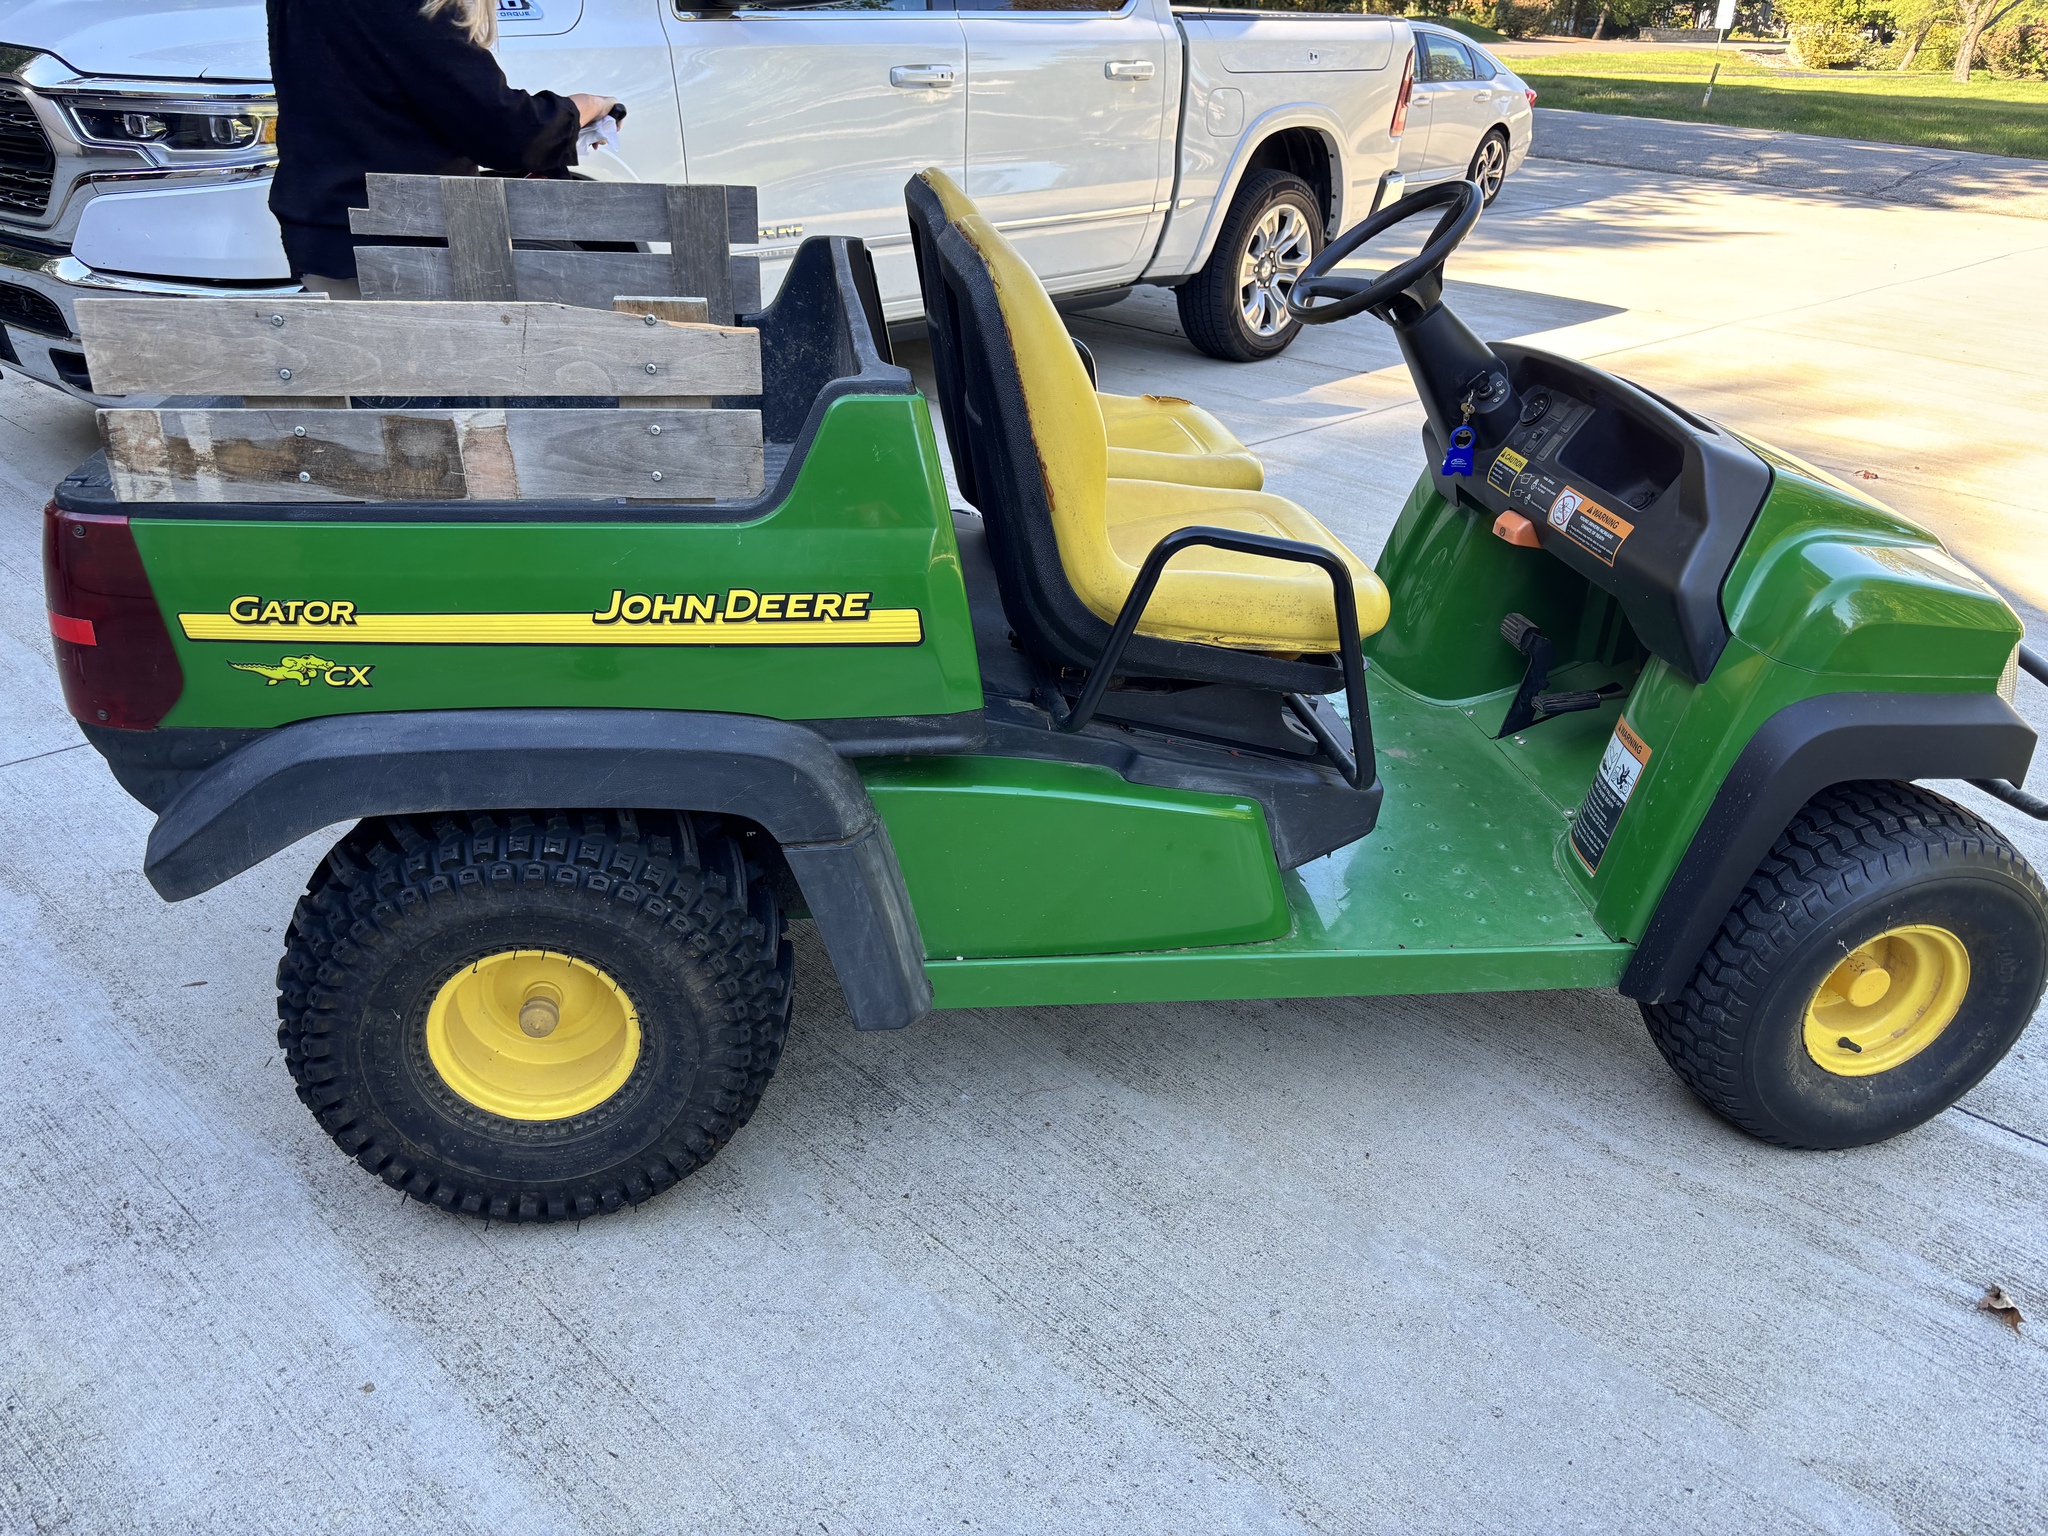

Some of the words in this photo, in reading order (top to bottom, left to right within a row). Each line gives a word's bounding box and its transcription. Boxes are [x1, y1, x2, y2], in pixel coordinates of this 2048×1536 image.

[758, 223, 803, 239] AM
[1504, 454, 1524, 469] CAUTION
[1592, 508, 1620, 530] WARNING
[228, 595, 358, 626] GATOR
[592, 589, 719, 623] JOHN
[722, 588, 873, 623] DEERE
[324, 665, 375, 688] CX
[1620, 726, 1643, 755] WARNING
